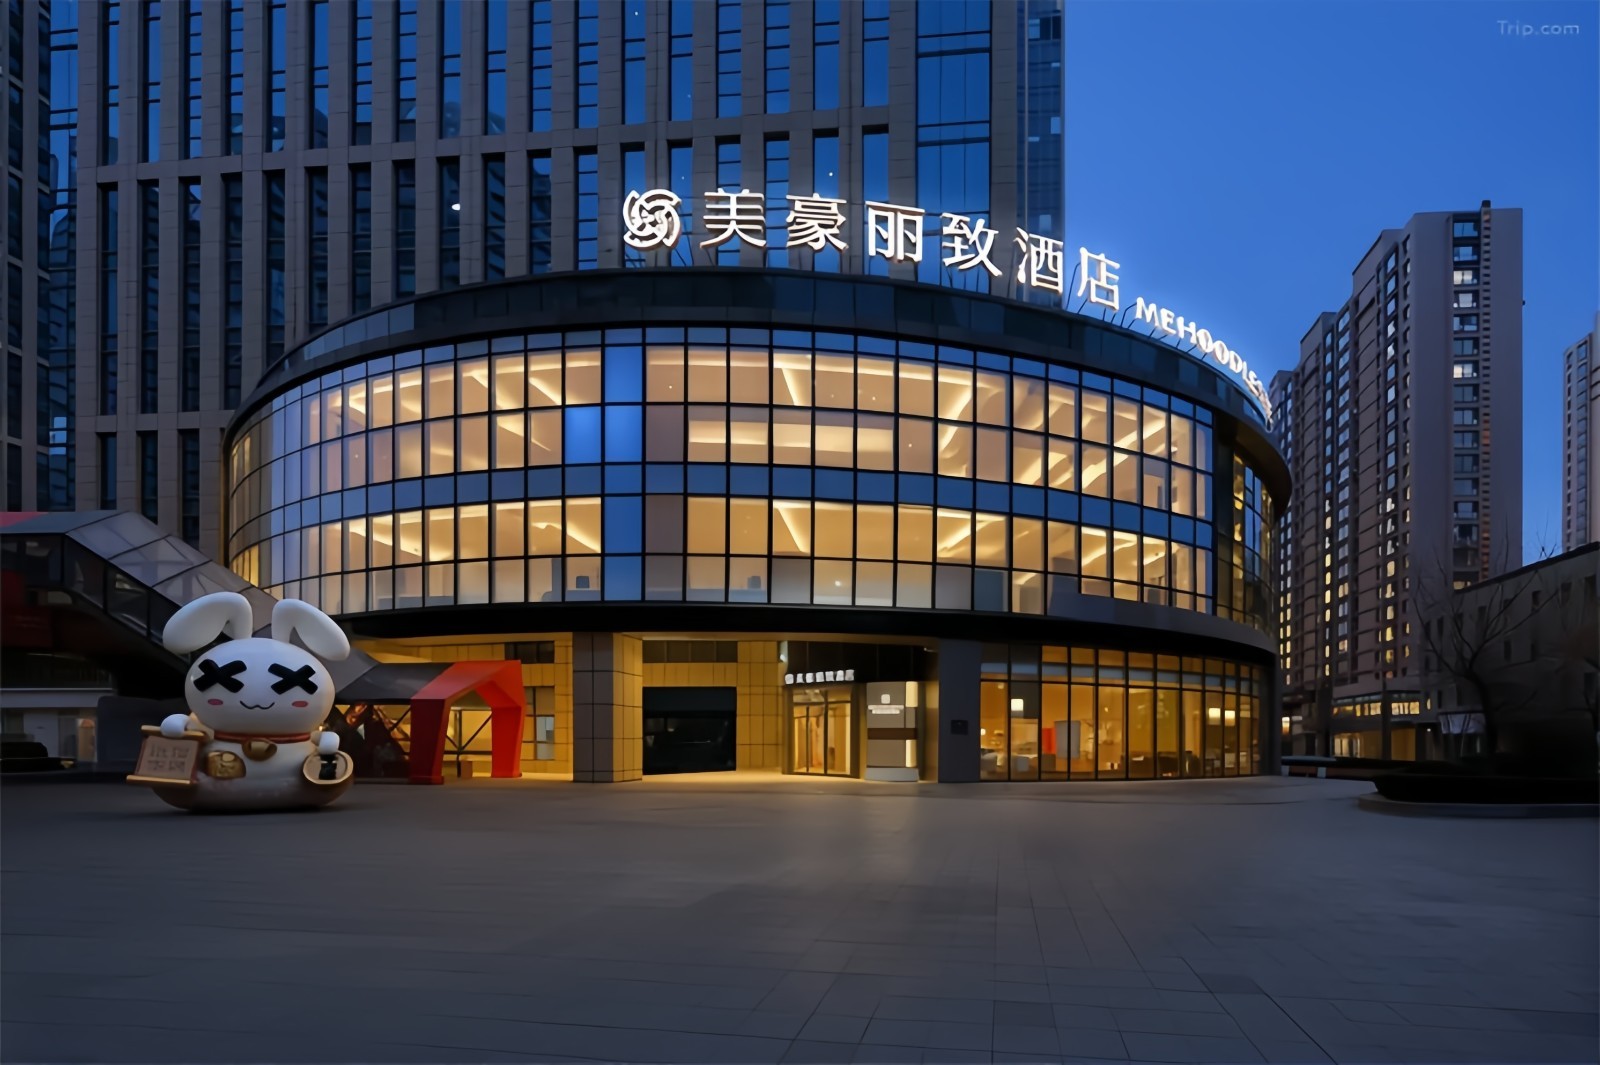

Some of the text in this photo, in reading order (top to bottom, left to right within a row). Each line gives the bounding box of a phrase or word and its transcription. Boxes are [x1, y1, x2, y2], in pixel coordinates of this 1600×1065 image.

[699, 187, 1121, 311] 美豪丽致酒店
